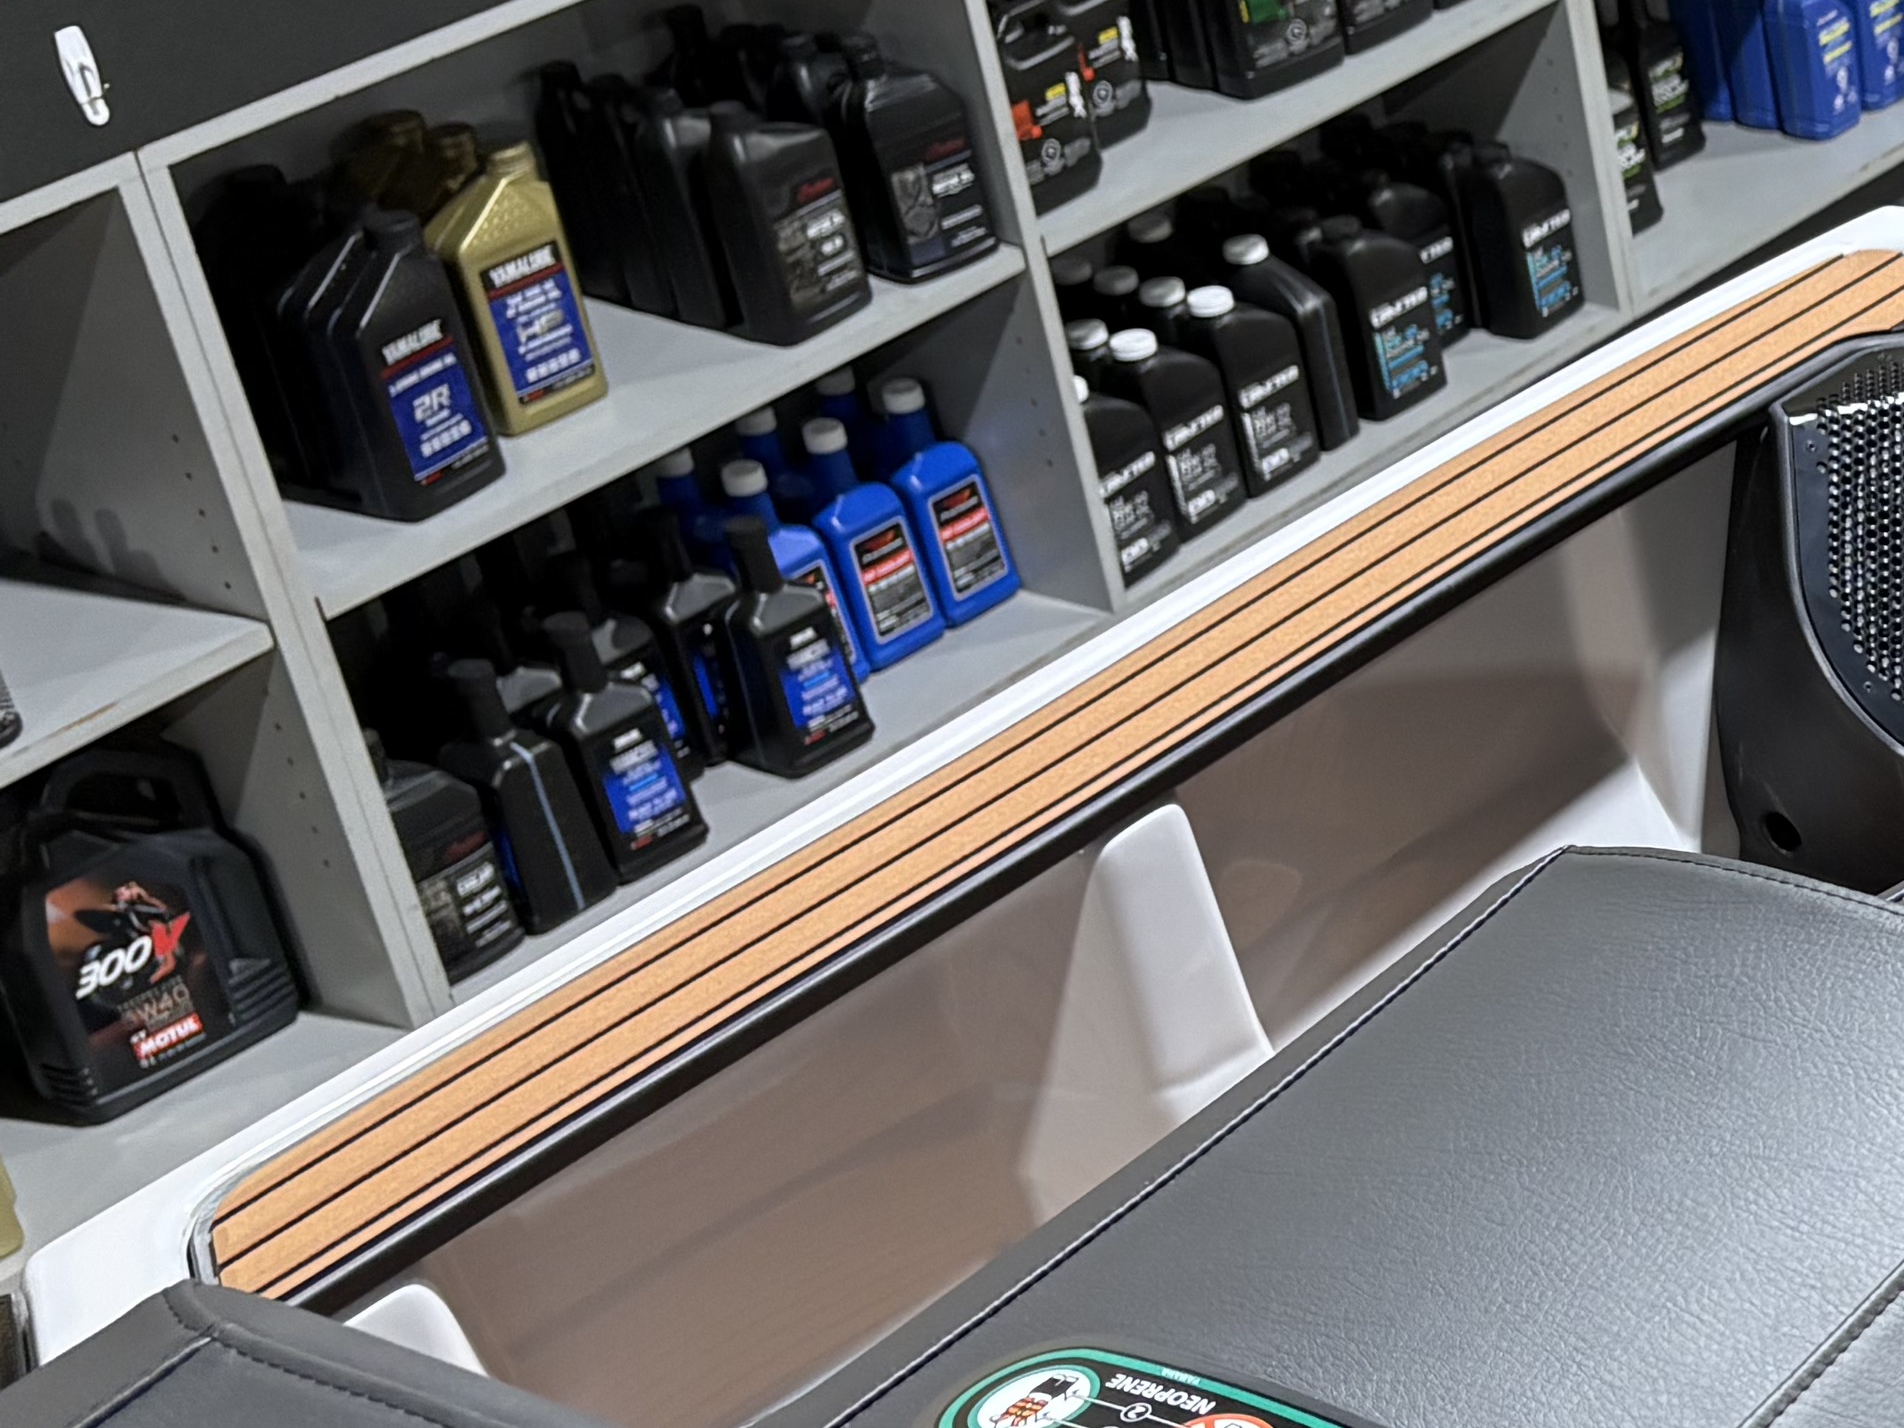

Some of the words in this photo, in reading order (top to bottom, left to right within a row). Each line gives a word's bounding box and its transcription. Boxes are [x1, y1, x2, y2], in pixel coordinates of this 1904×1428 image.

[487, 243, 557, 290] YAMALUBE
[381, 318, 444, 367] YAMALUBE
[411, 383, 452, 423] 2R
[74, 911, 191, 1001] 300V
[138, 1013, 199, 1056] MOTUL
[1105, 1373, 1217, 1416] NEOPRENE
[1128, 1405, 1145, 1419] 2
